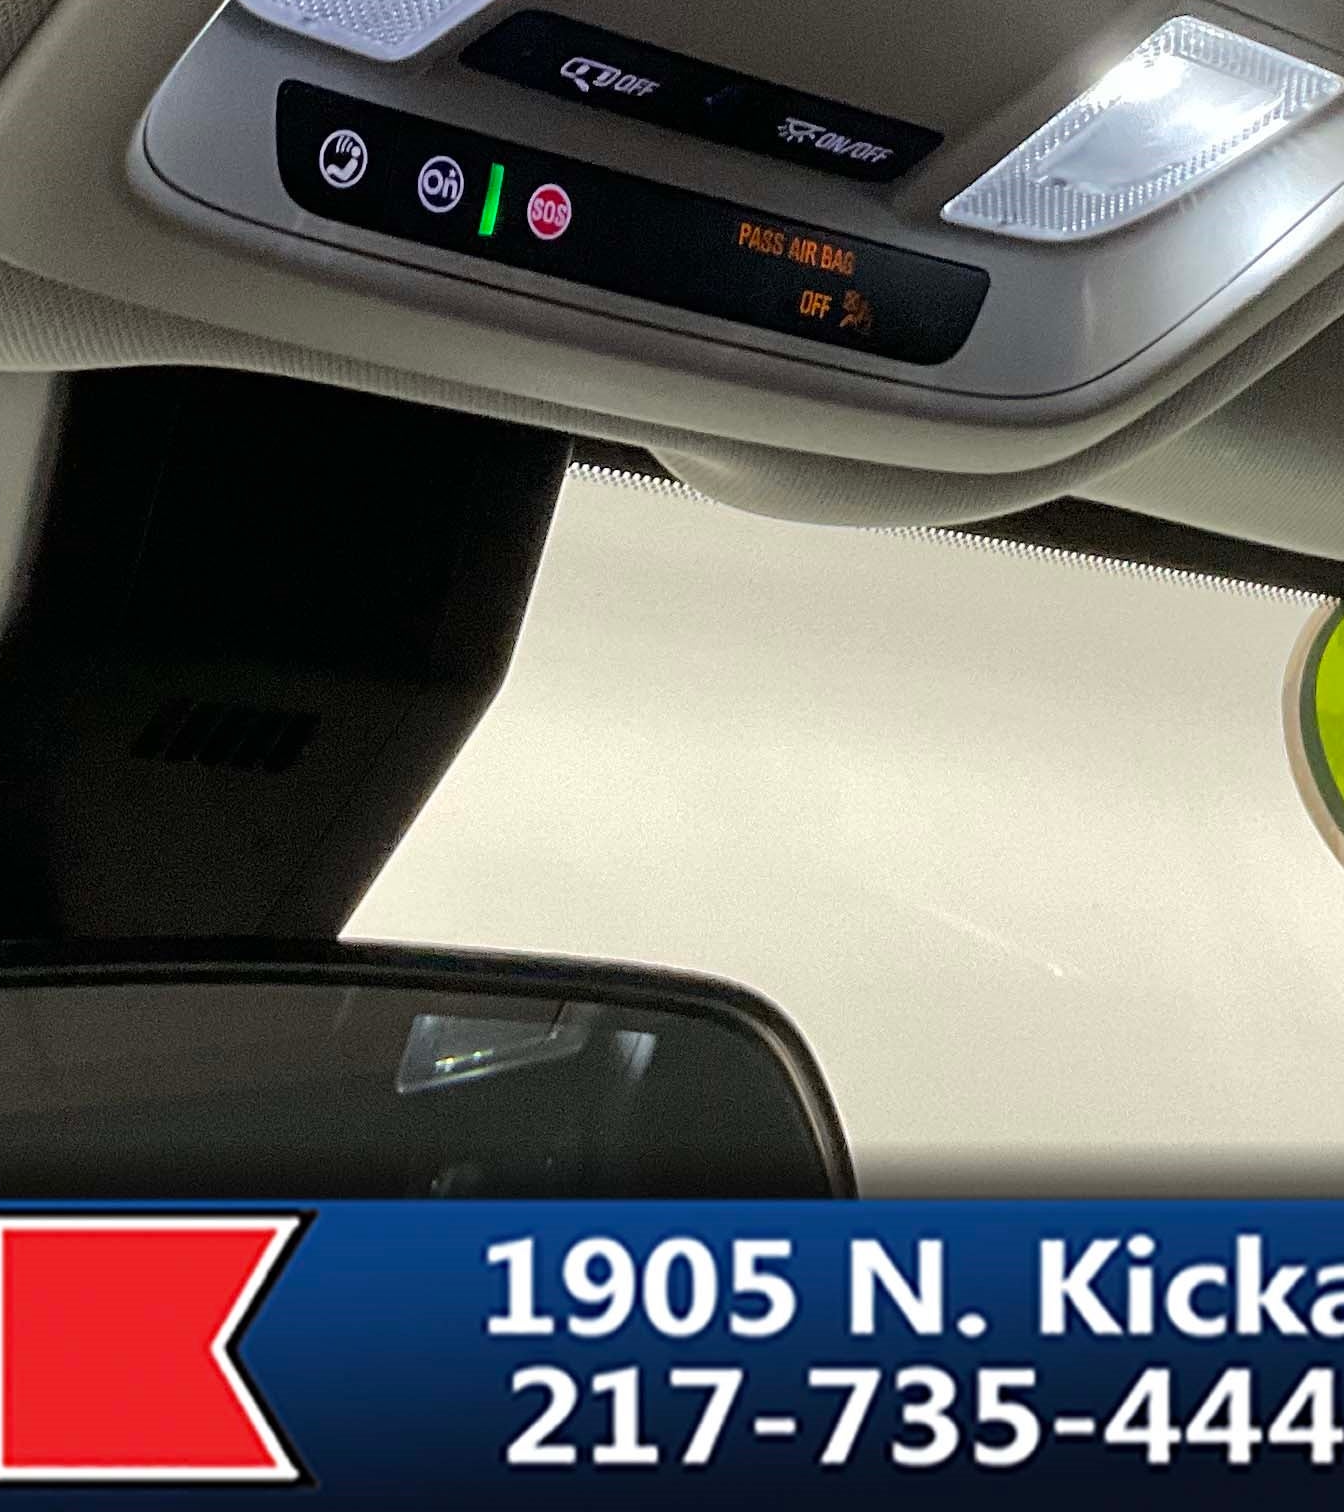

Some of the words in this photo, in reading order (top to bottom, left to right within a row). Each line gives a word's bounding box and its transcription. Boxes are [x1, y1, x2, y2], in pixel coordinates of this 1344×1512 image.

[614, 73, 661, 97] OFF
[814, 131, 895, 164] ON/OFF
[531, 196, 569, 228] SOS
[737, 222, 786, 257] PASS
[787, 236, 818, 268] AIR
[820, 243, 856, 276] BAG
[799, 289, 833, 320] OFF
